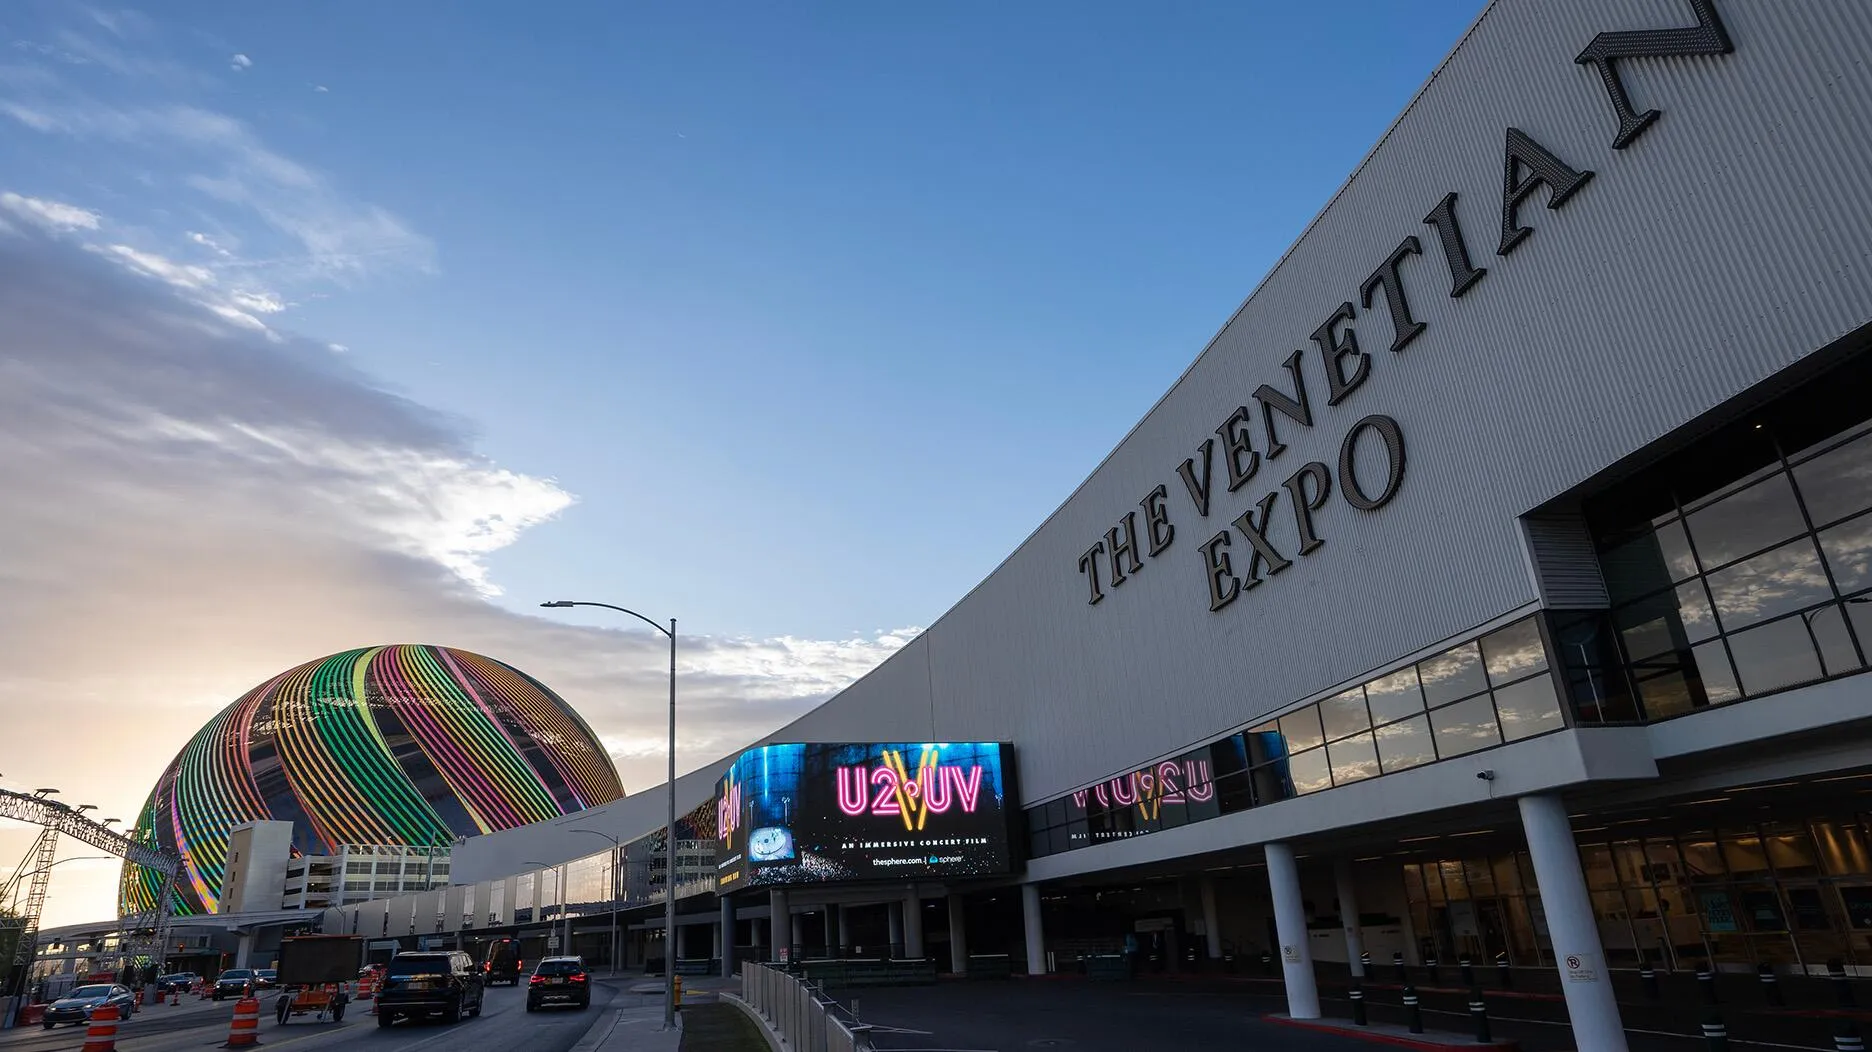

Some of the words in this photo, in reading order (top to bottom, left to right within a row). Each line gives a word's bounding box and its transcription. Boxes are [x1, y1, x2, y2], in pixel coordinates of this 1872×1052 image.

[1078, 484, 1175, 605] THE
[1175, 0, 1735, 517] VENETIAN
[1197, 414, 1407, 612] EXPO
[859, 840, 915, 849] IMMERSIVE
[919, 838, 961, 847] CONCERT
[965, 837, 987, 845] FILM
[872, 857, 923, 867] thesphere.com
